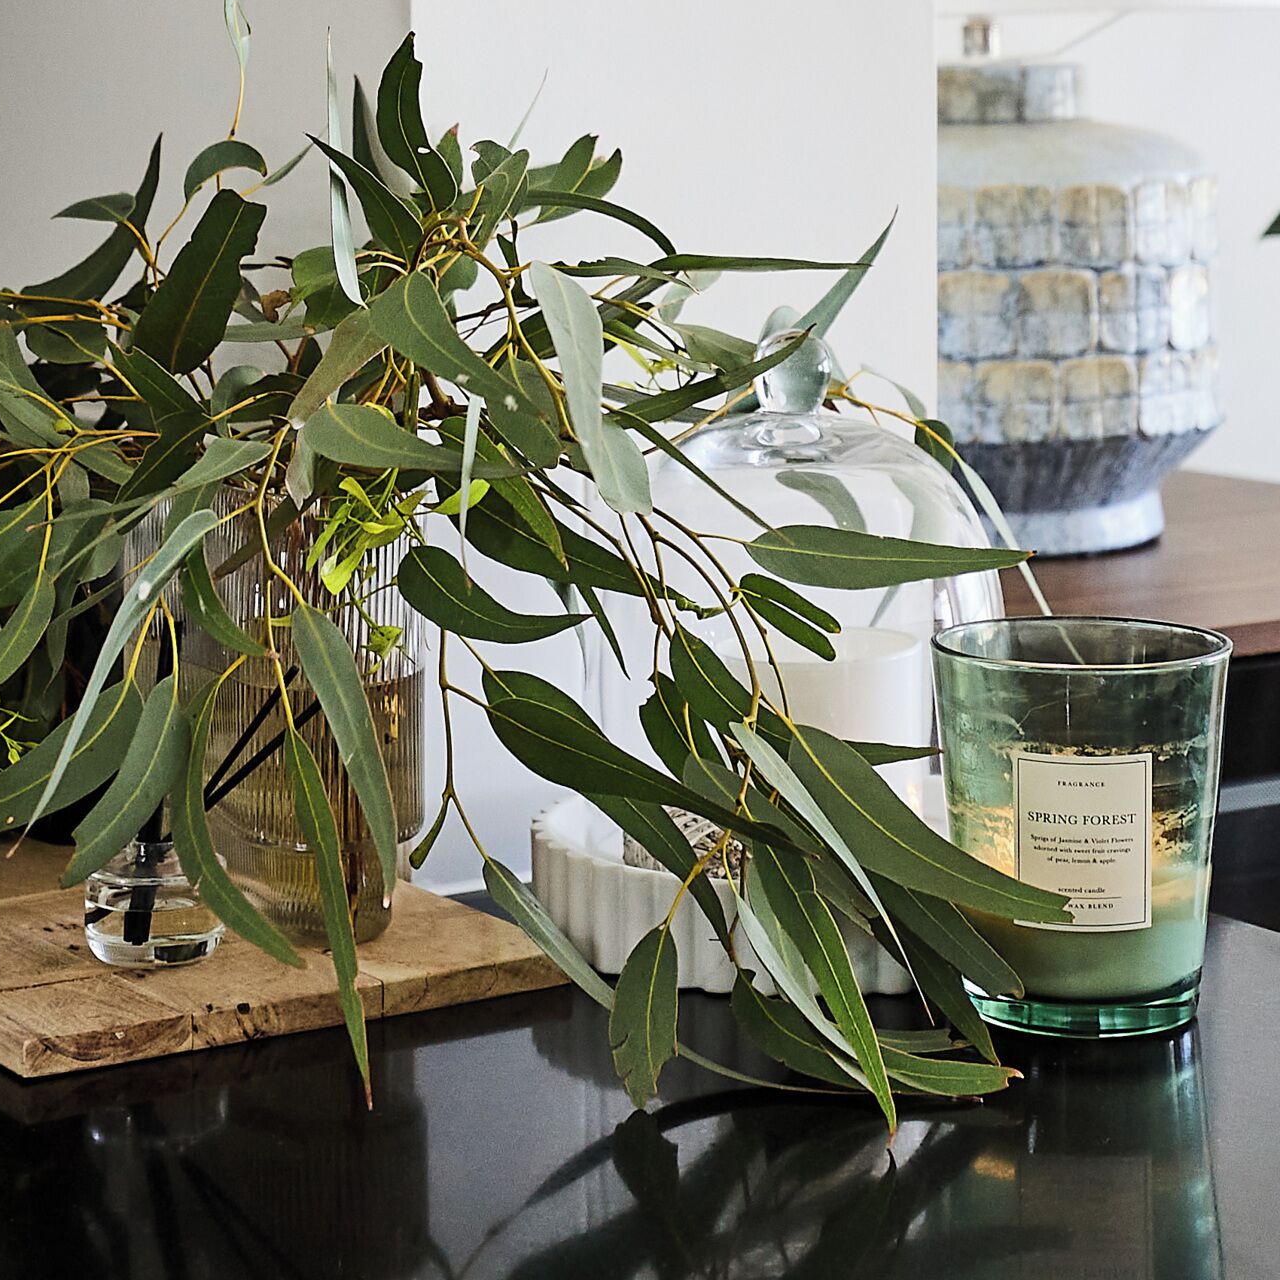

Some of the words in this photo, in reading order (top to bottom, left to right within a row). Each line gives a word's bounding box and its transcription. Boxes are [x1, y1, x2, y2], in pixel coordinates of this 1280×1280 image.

[1027, 811, 1078, 825] SPRING
[1082, 813, 1137, 826] FOREST
[1030, 834, 1049, 842] Sprigs
[1058, 836, 1082, 845] Jasmine
